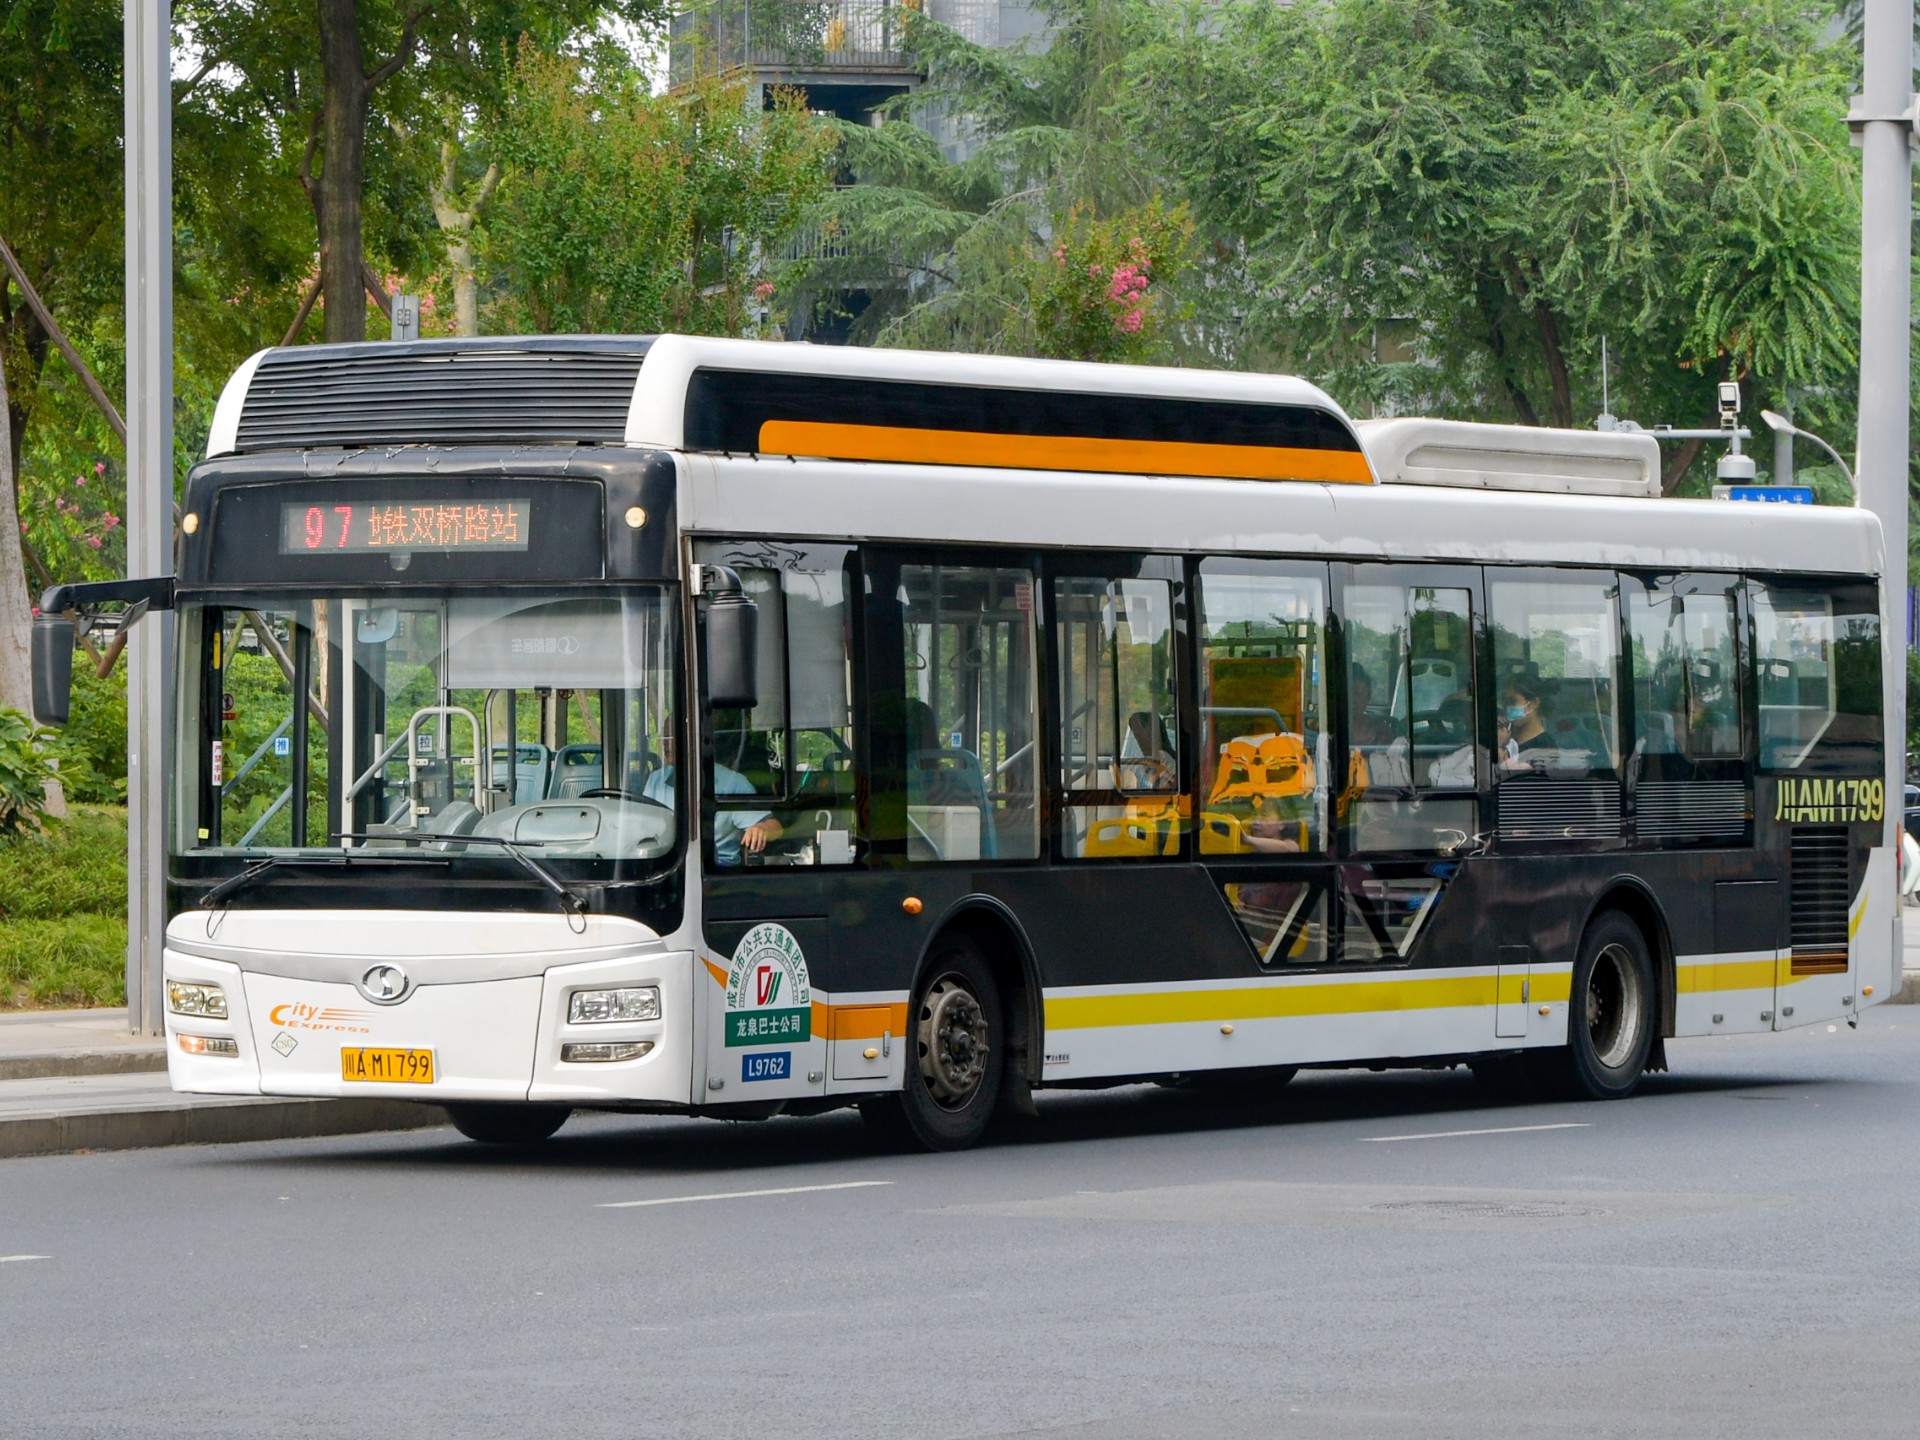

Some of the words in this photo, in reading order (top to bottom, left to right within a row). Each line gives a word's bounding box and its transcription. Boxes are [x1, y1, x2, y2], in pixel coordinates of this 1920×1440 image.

[304, 507, 352, 548] 97
[727, 926, 810, 1009] 成都市公共交通集团公司
[269, 1002, 318, 1026] City
[288, 1020, 370, 1033] Express
[736, 1015, 800, 1037] 龙泉巴士公司
[275, 1039, 294, 1050] CNG
[748, 1057, 784, 1077] L9762
